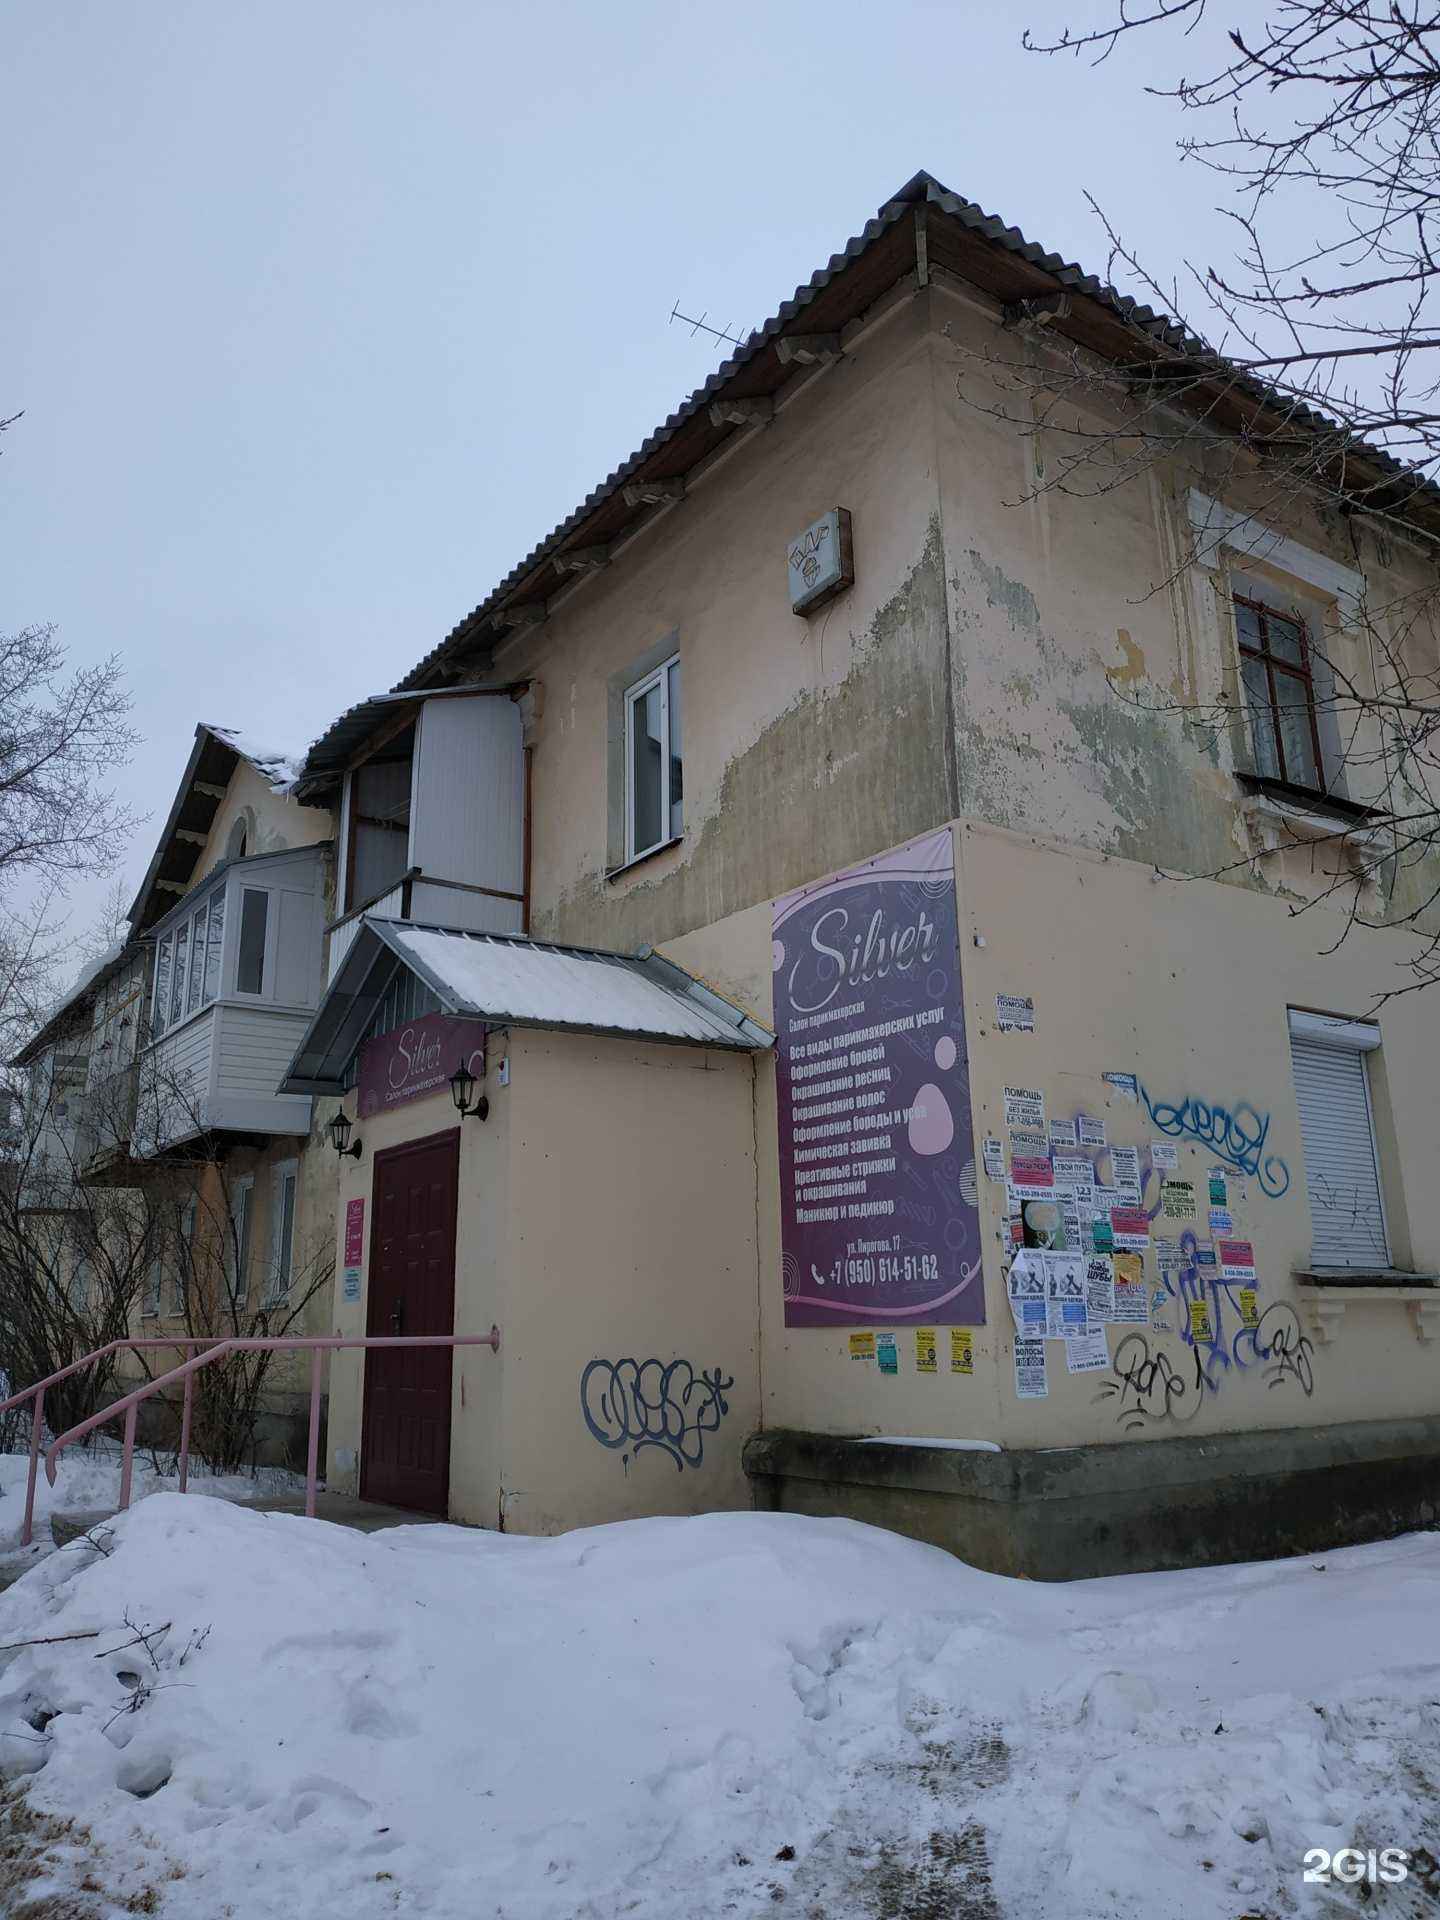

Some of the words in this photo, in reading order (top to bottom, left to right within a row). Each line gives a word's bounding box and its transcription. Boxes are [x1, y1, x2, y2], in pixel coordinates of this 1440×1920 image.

[789, 908, 937, 1012] Silver
[789, 1015, 809, 1033] Салон
[790, 1045, 806, 1061] Все
[806, 1039, 833, 1057] виды
[833, 1014, 915, 1048] парикмахерских
[916, 1007, 945, 1028] услуг
[791, 1055, 849, 1081] Оформление
[850, 1043, 886, 1067] бровей
[791, 1076, 855, 1101] Окрашивание
[855, 1066, 892, 1089] ресниц
[1004, 1087, 1042, 1100] ПОМОЩЬ
[792, 1097, 855, 1122] Окрашивание
[855, 1090, 886, 1109] волос
[793, 1119, 852, 1143] Оформление
[853, 1112, 893, 1132] бороды
[894, 1110, 901, 1123] и
[1009, 1134, 1047, 1146] ПОМОЩЬ
[794, 1142, 849, 1164] Химическая
[850, 1135, 892, 1154] завивка
[794, 1163, 851, 1186] Креативные
[852, 1157, 896, 1177] стрижки
[795, 1190, 802, 1203] и
[802, 1180, 867, 1201] окрашивания
[796, 1206, 839, 1224] Маникюр
[840, 1205, 847, 1219] и
[848, 1200, 895, 1218] педикюр
[847, 1242, 857, 1258] ул.
[893, 1234, 901, 1251] 17
[830, 1261, 841, 1285] +7
[845, 1257, 876, 1287] (950)
[879, 1254, 938, 1282] 614-51-62
